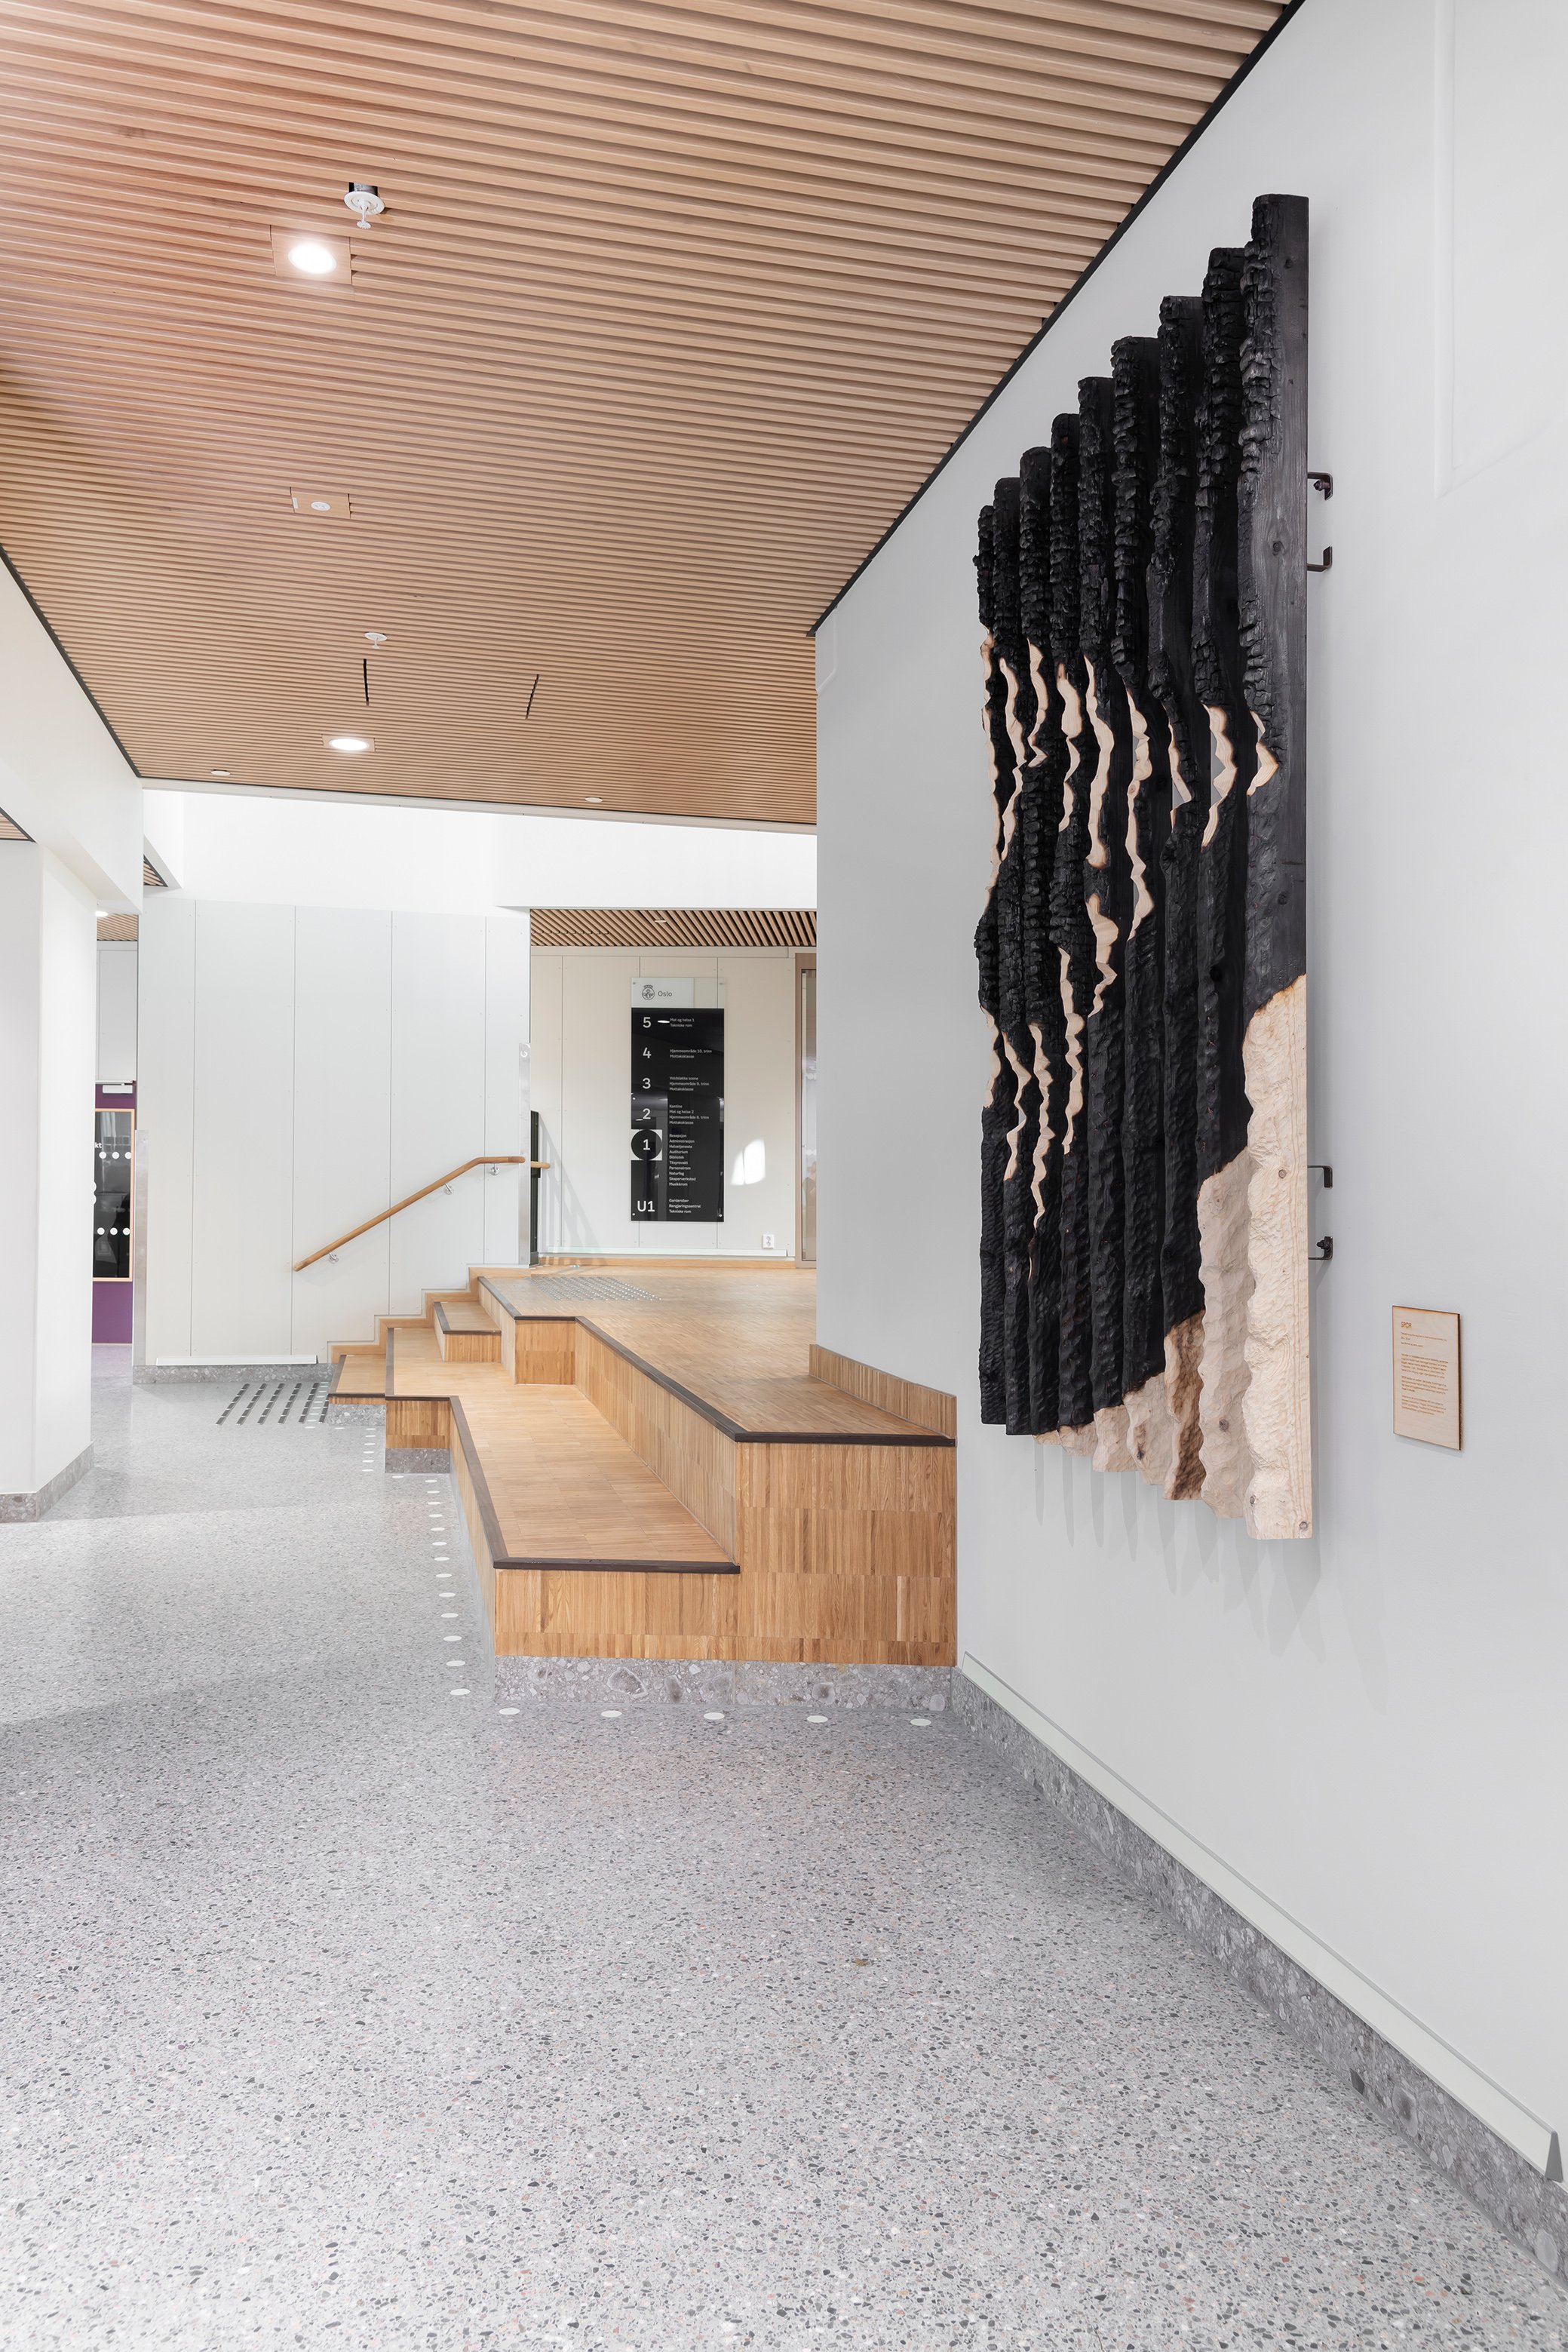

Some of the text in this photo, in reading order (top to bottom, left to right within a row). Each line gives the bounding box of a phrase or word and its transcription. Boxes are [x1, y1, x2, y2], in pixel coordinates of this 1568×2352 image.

[643, 1017, 652, 1028] 5
[643, 1047, 652, 1058] 4
[643, 1078, 651, 1089] 3
[643, 1108, 651, 1119] 2
[643, 1139, 651, 1150] 1
[637, 1200, 655, 1212] U1
